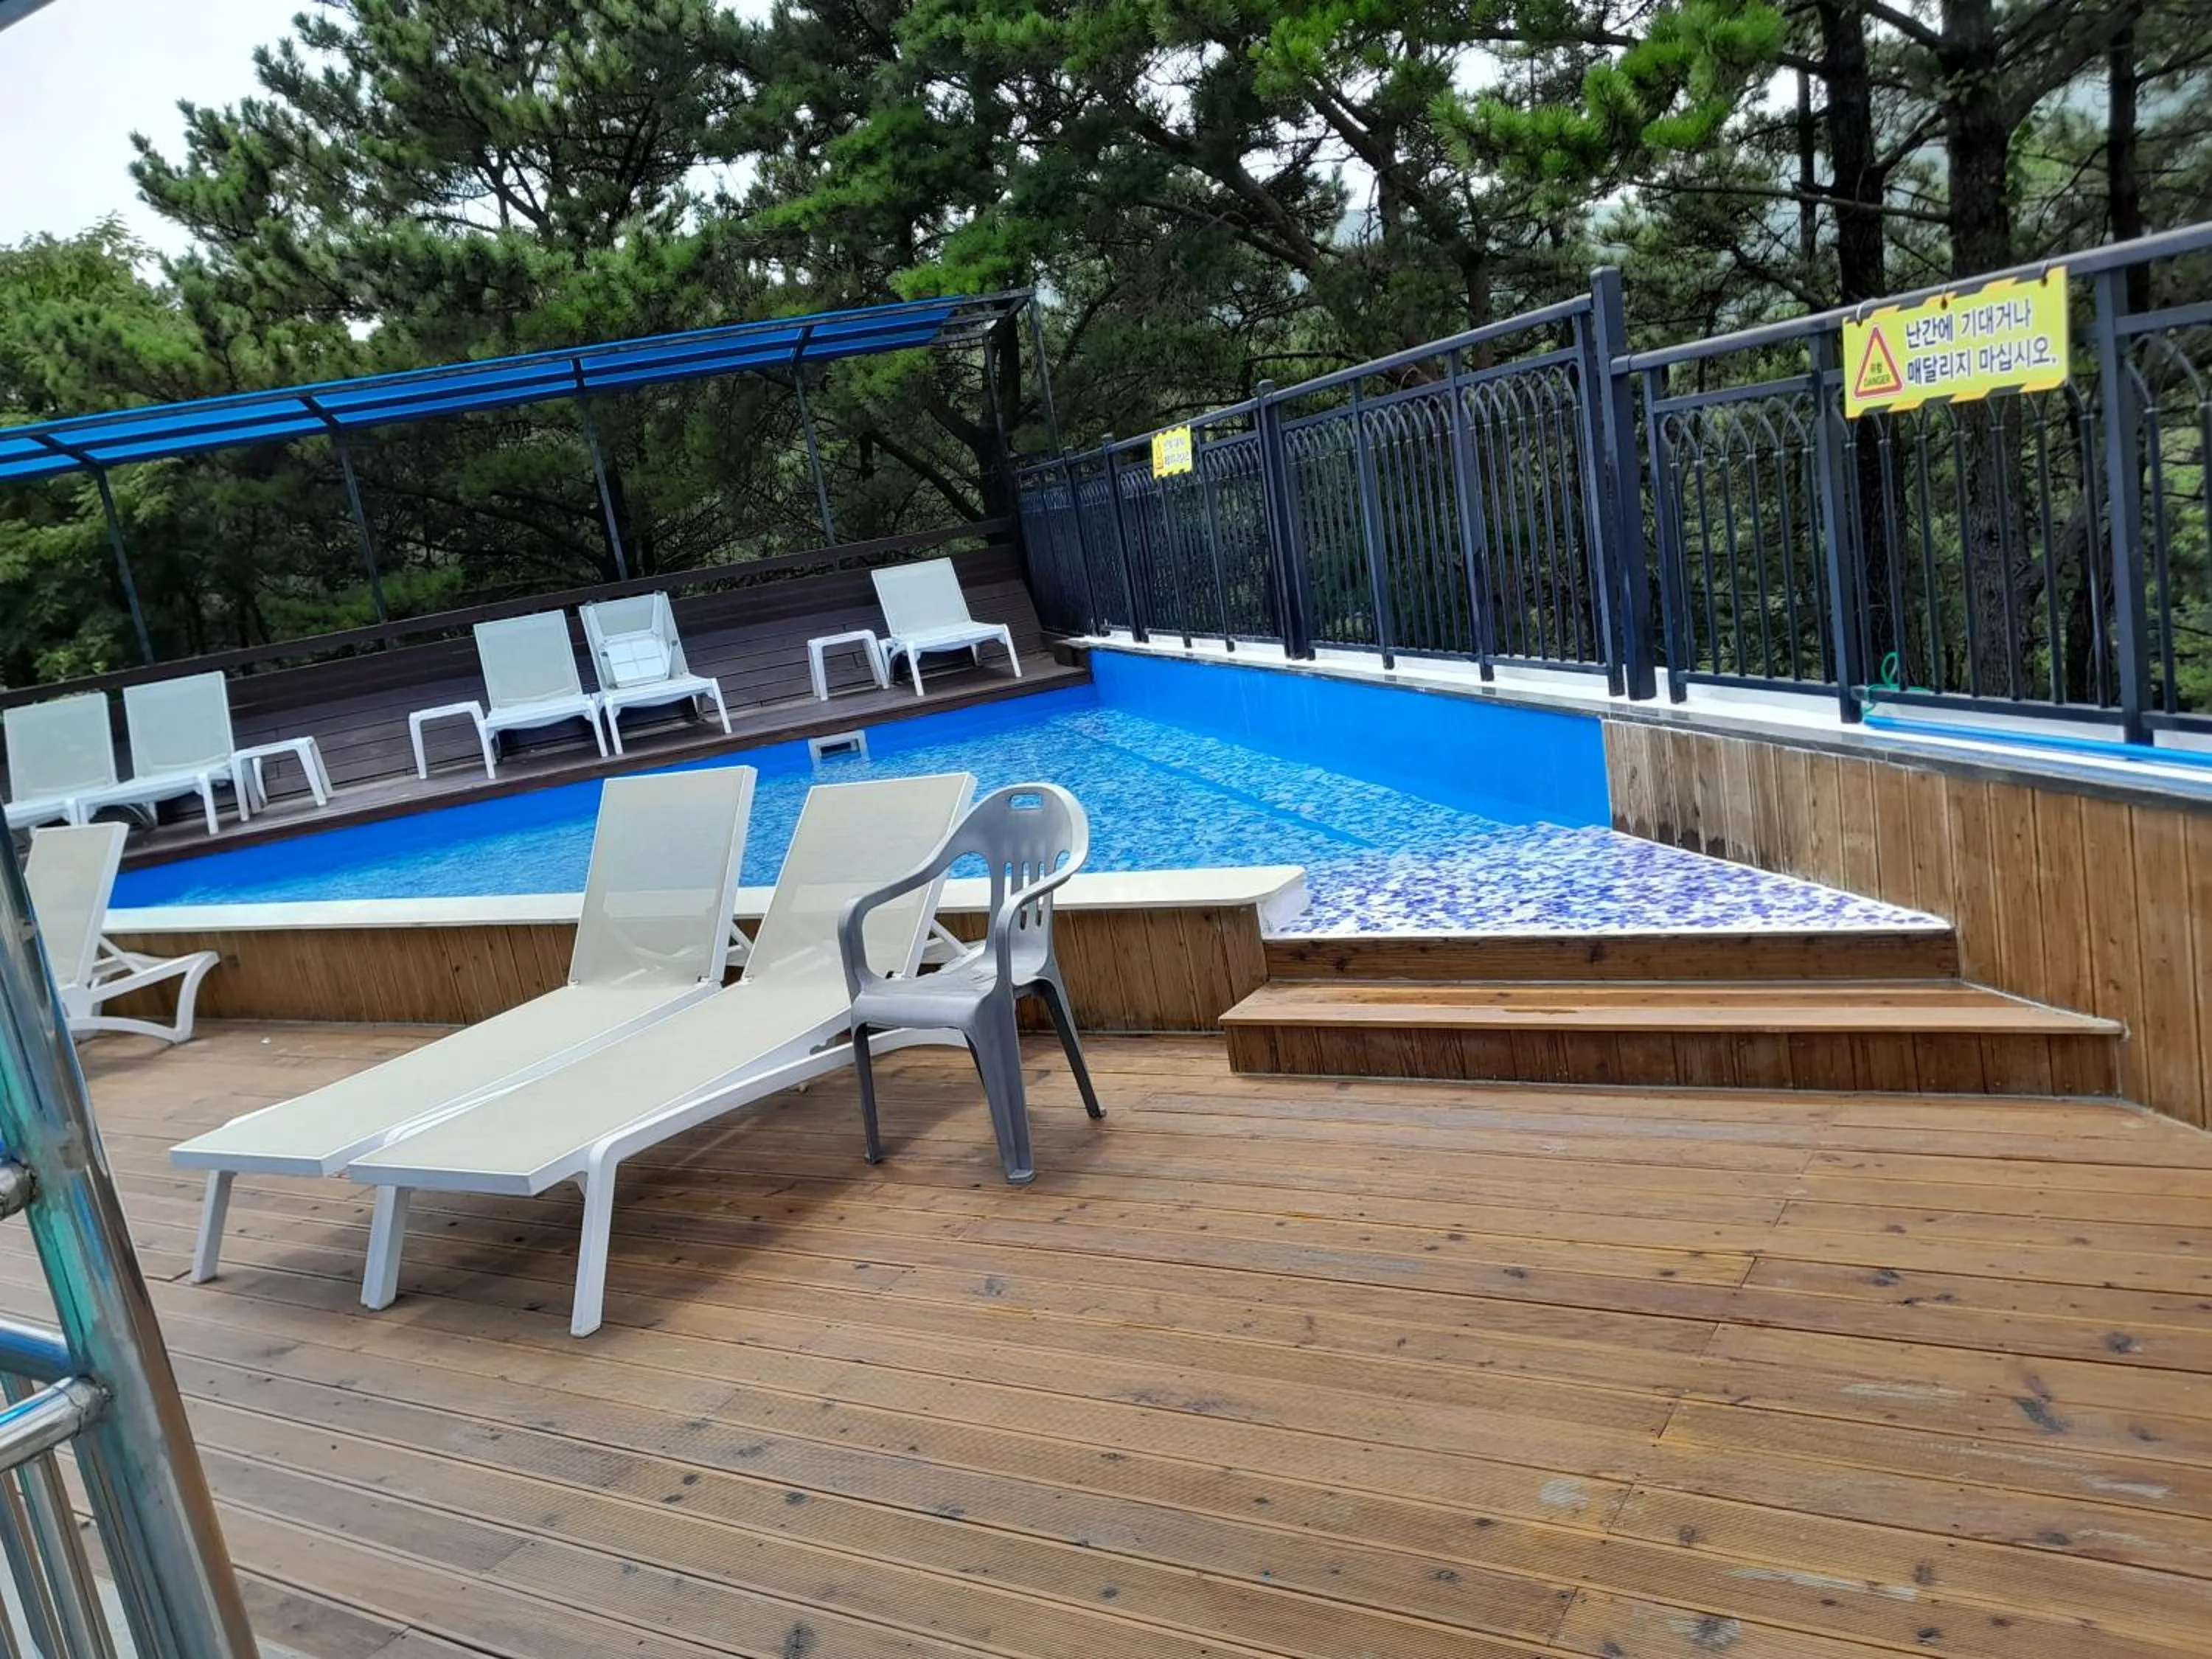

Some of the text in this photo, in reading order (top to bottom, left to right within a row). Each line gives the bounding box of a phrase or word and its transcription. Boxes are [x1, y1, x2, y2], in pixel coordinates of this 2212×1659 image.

[1906, 299, 2031, 349] 난간에 기대거나
[1864, 374, 1890, 387] DANGER
[1907, 337, 2057, 385] 매달리지 마십시오.
